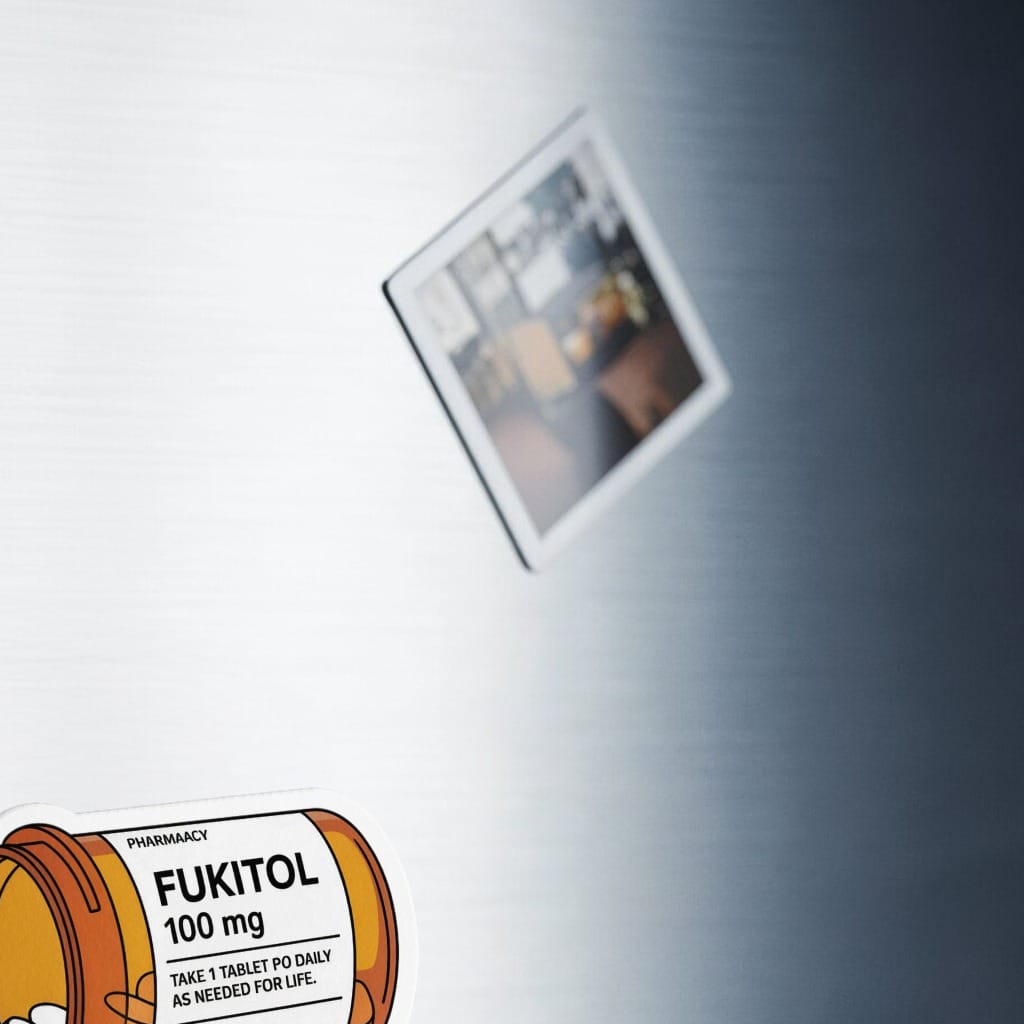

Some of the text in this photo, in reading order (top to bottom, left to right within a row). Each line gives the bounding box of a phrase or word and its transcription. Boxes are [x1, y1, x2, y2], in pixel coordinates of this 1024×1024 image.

[126, 829, 208, 849] PHARMAACY
[153, 851, 319, 907] FUKITOL
[163, 911, 265, 945] 100 mg
[169, 948, 332, 988] TAKE 1 TABLET PO DAILY
[172, 971, 317, 1009] AS NEEDED FOR LIFE.
